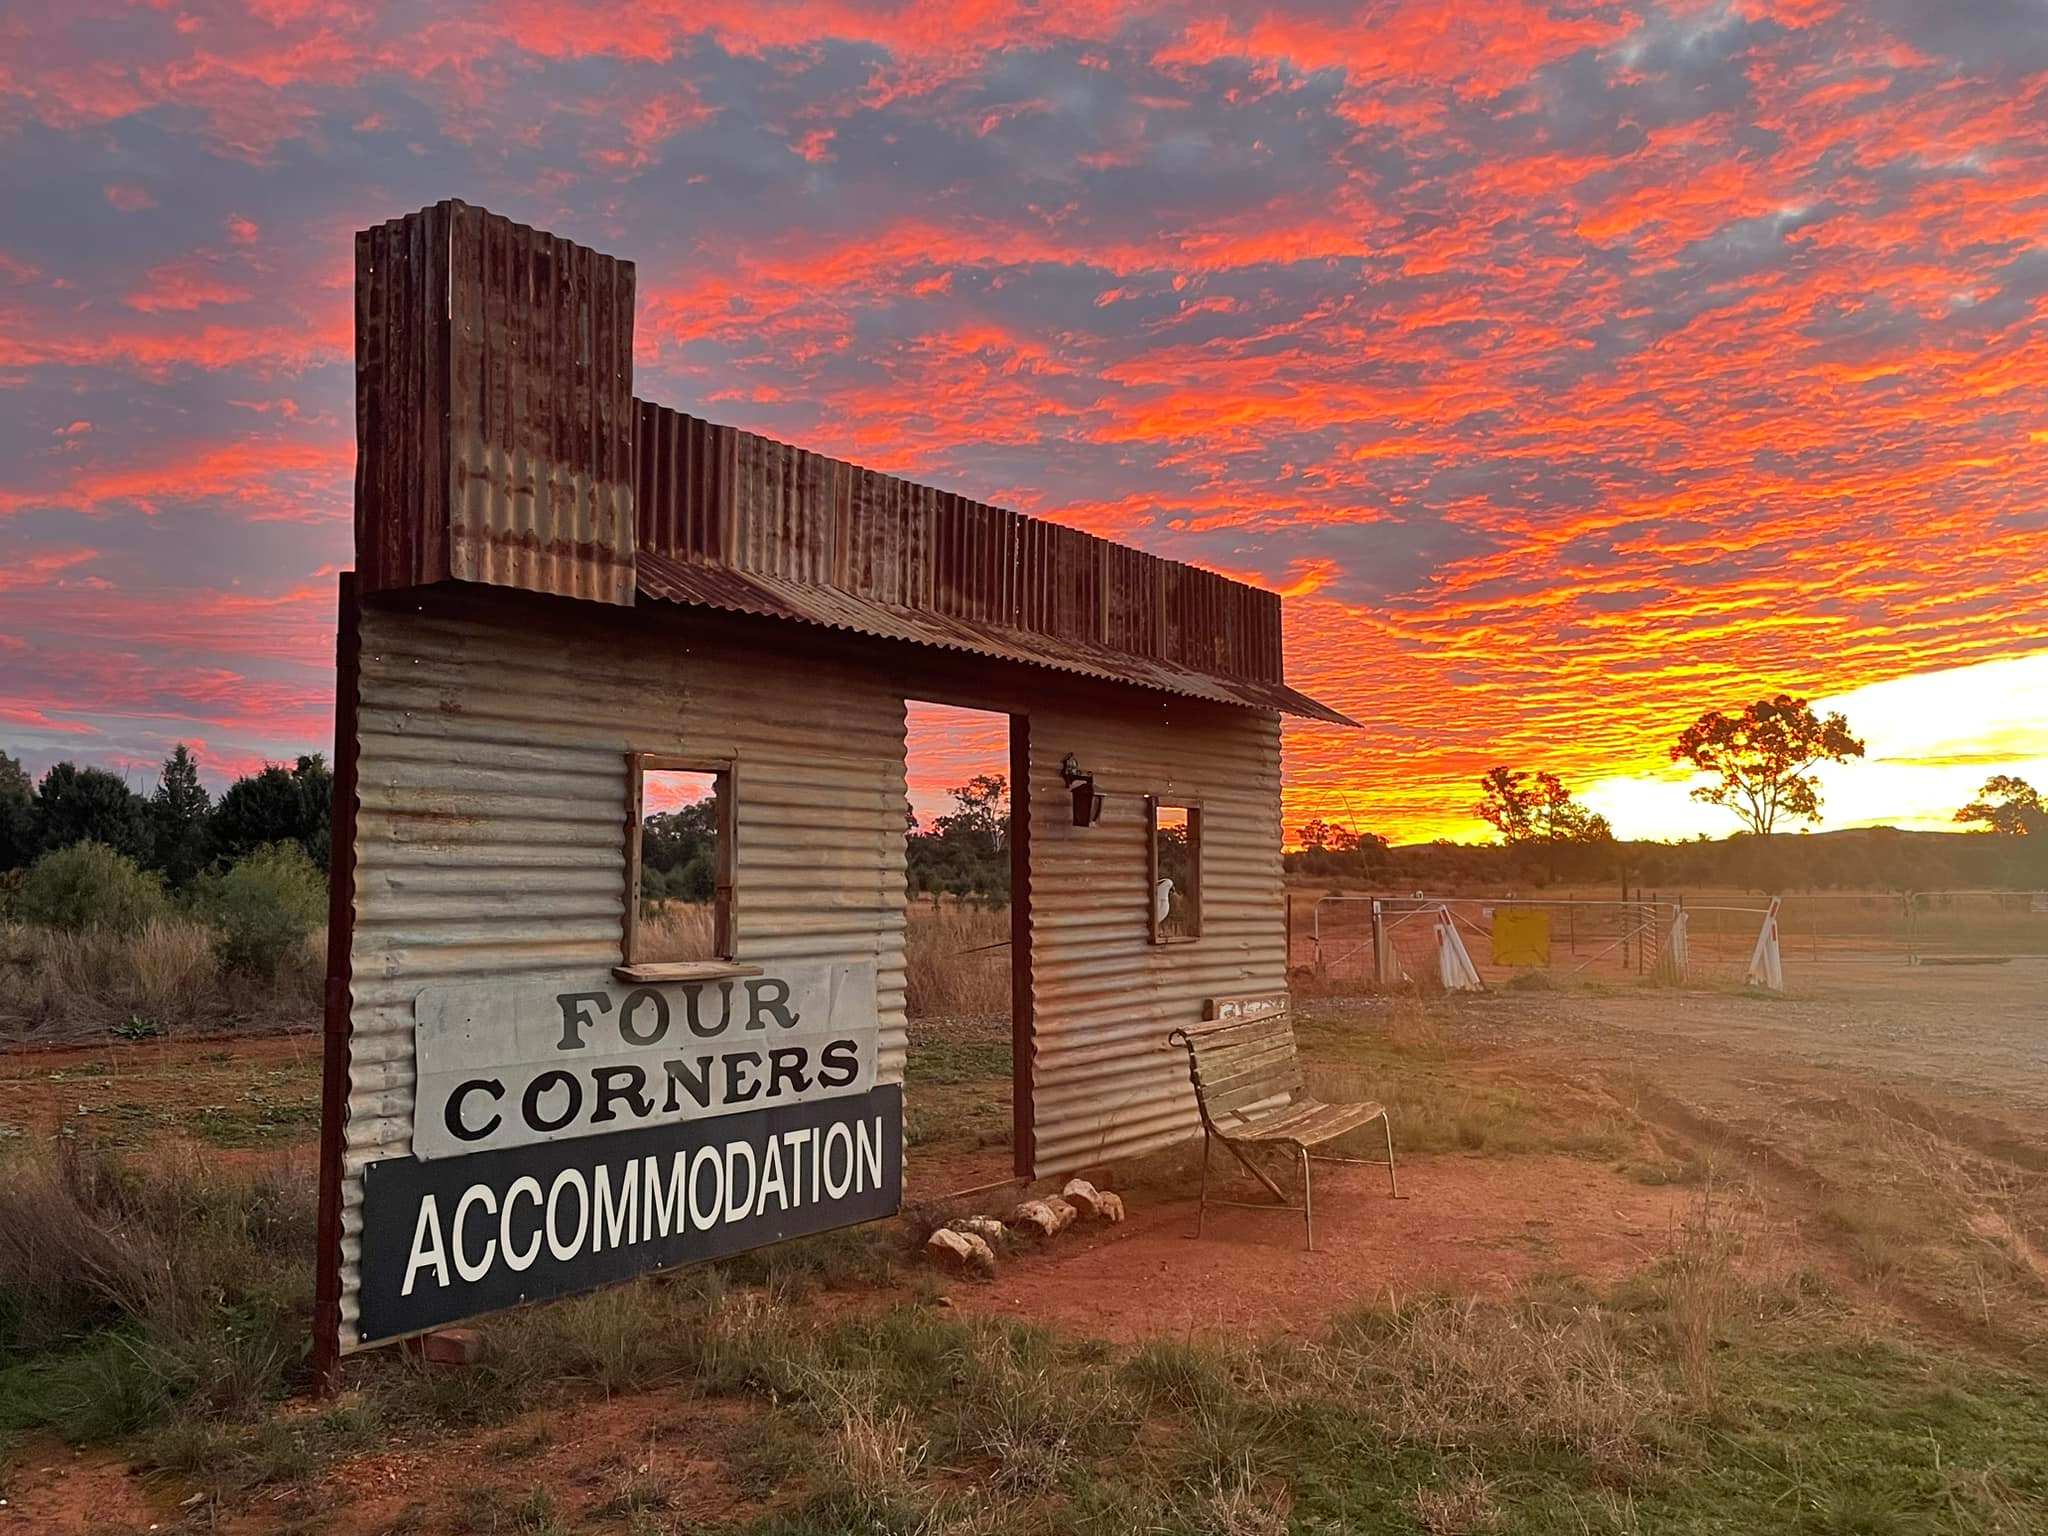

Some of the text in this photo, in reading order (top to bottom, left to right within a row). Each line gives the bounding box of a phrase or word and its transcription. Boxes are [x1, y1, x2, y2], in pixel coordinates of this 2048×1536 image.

[557, 979, 799, 1050] FOUR
[444, 1040, 859, 1141] CORNERS
[401, 1116, 883, 1296] ACCOMMODATION
